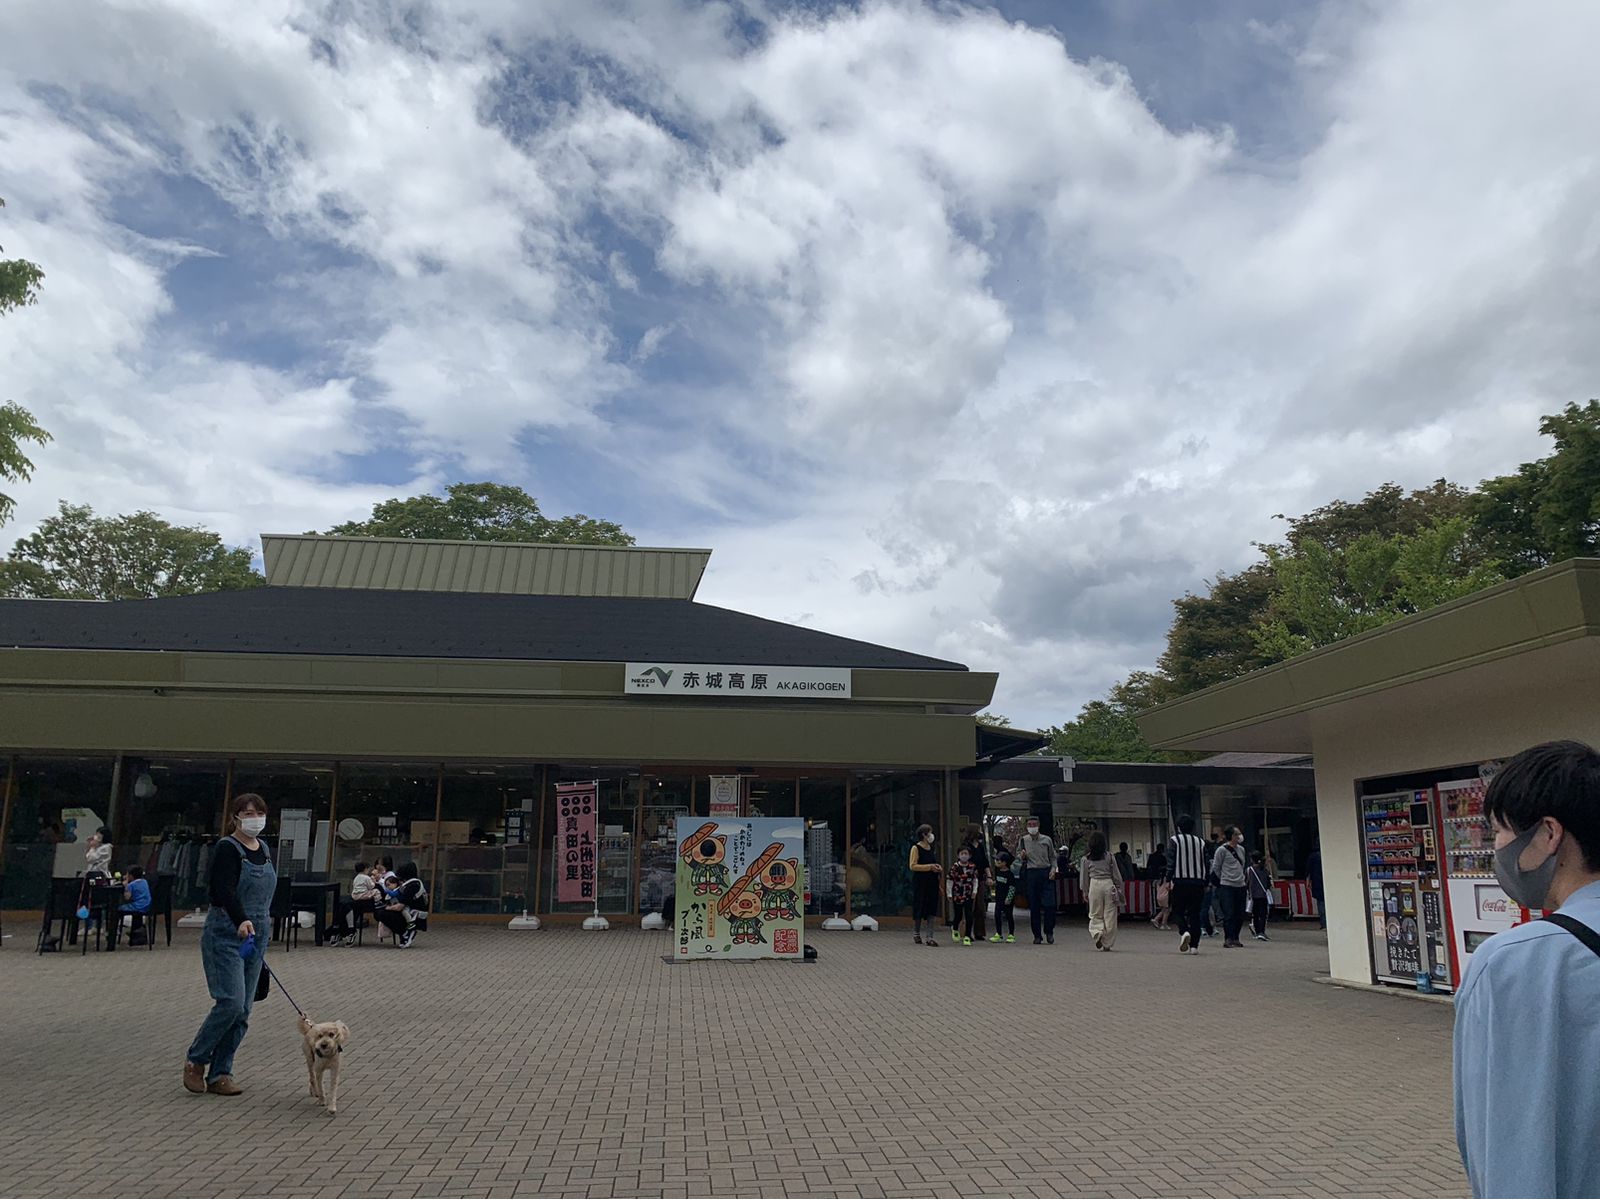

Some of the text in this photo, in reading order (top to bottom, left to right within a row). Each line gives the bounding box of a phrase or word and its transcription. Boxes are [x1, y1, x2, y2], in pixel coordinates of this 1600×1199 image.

[682, 672, 846, 691] 赤城高原 AKAGIKOGEN
